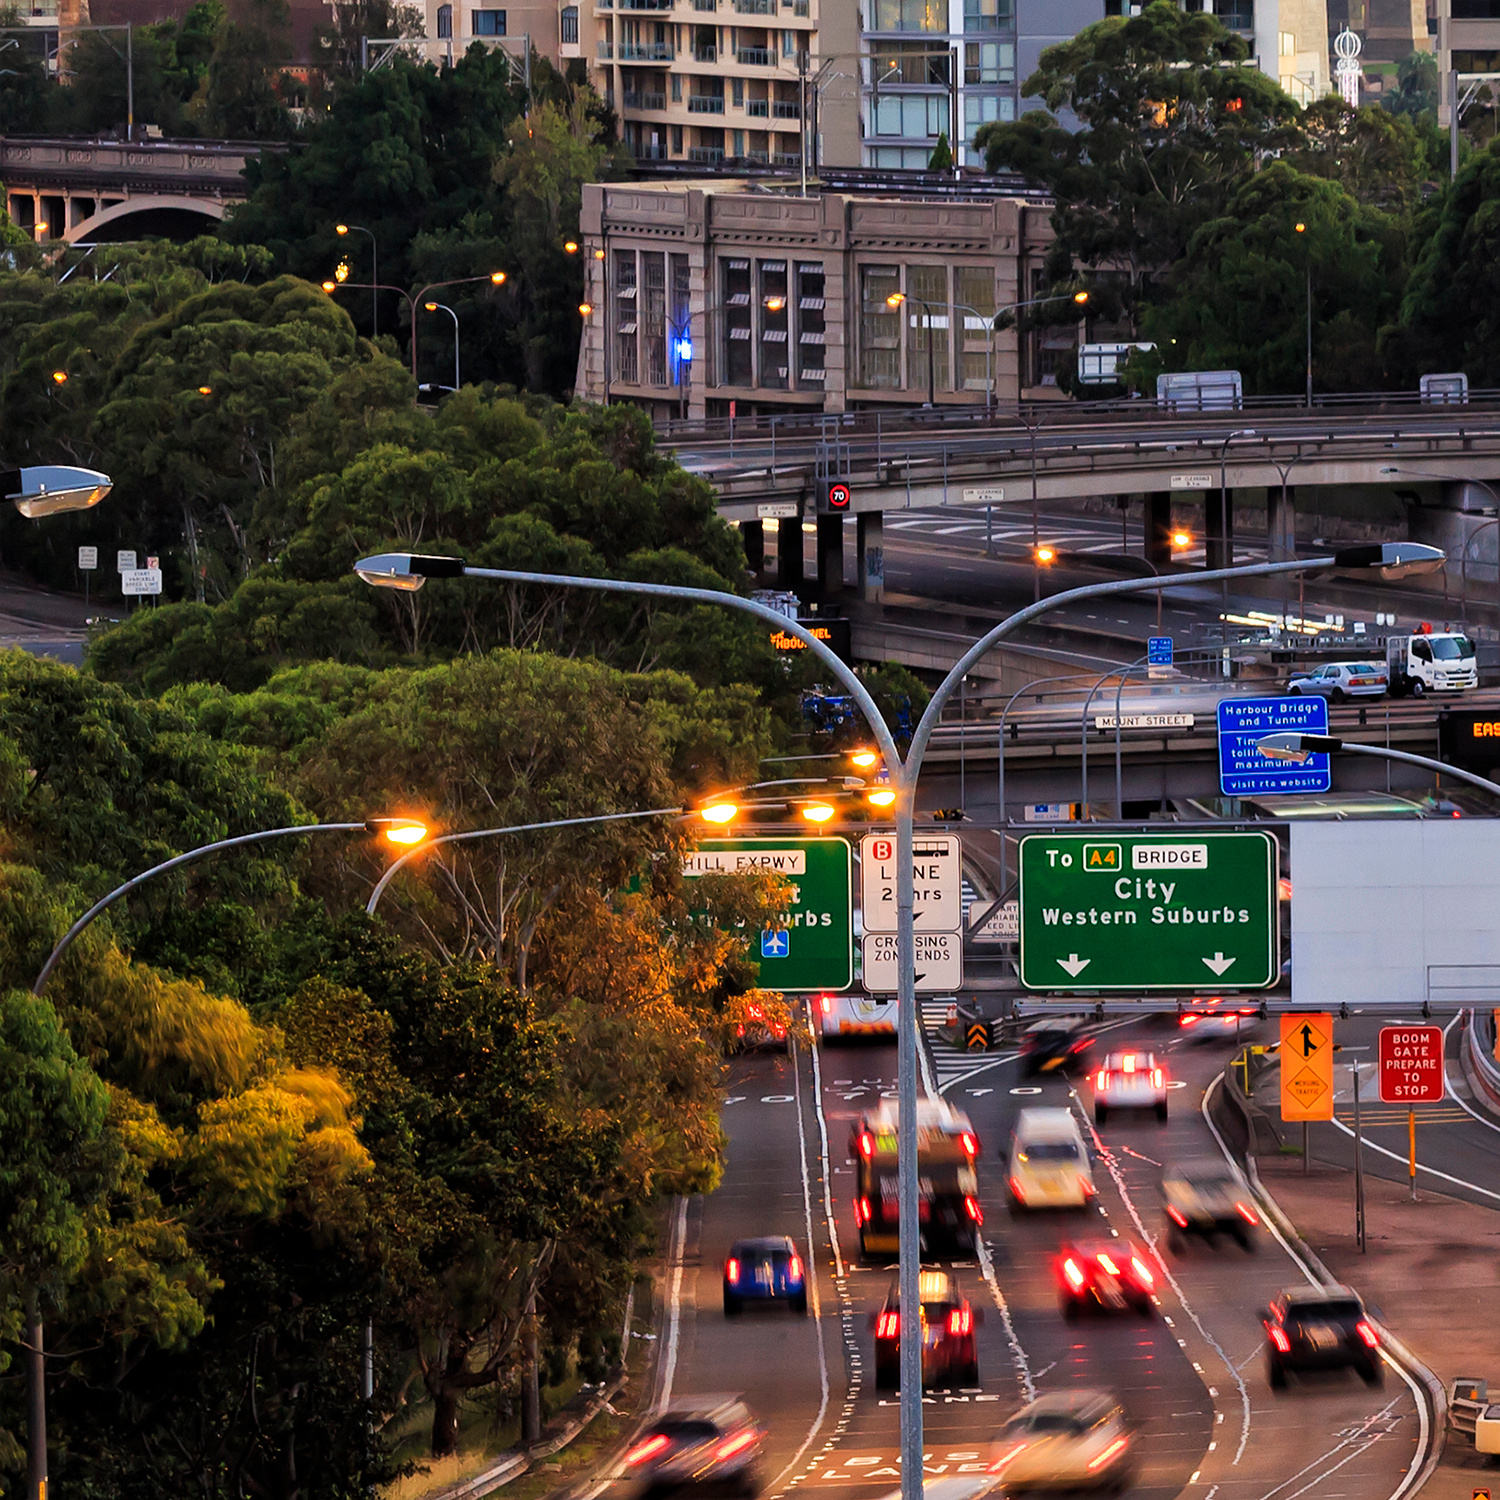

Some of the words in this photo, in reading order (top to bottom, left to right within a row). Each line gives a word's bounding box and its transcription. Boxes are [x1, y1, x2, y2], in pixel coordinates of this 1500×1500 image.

[833, 491, 845, 501] 70
[1225, 706, 1273, 715] Harbour
[1280, 703, 1319, 714] Bridge
[1102, 716, 1140, 727] MOUNT
[1146, 715, 1187, 725] STREET
[1239, 717, 1260, 726] and
[1267, 715, 1307, 725] Tunnel
[1235, 760, 1293, 769] maximum
[1231, 779, 1255, 789] visit
[1260, 779, 1276, 787] rta
[1280, 777, 1322, 787] website
[683, 857, 722, 870] HILL
[736, 855, 799, 869] EXPWY
[1045, 849, 1073, 868] To
[1089, 850, 1116, 866] A4
[1137, 850, 1202, 864] BRIDGE
[881, 865, 940, 880] LNE
[1114, 877, 1176, 904] City
[1042, 907, 1138, 926] Western
[1150, 906, 1250, 924] Suburbs
[916, 950, 950, 961] ENDS
[1392, 1033, 1430, 1044] BOOM
[1393, 1047, 1429, 1057] GATE
[1386, 1059, 1436, 1070] PREPARE
[1403, 1072, 1420, 1083] TO
[965, 1087, 1043, 1097] 70
[1394, 1085, 1429, 1096] STOP
